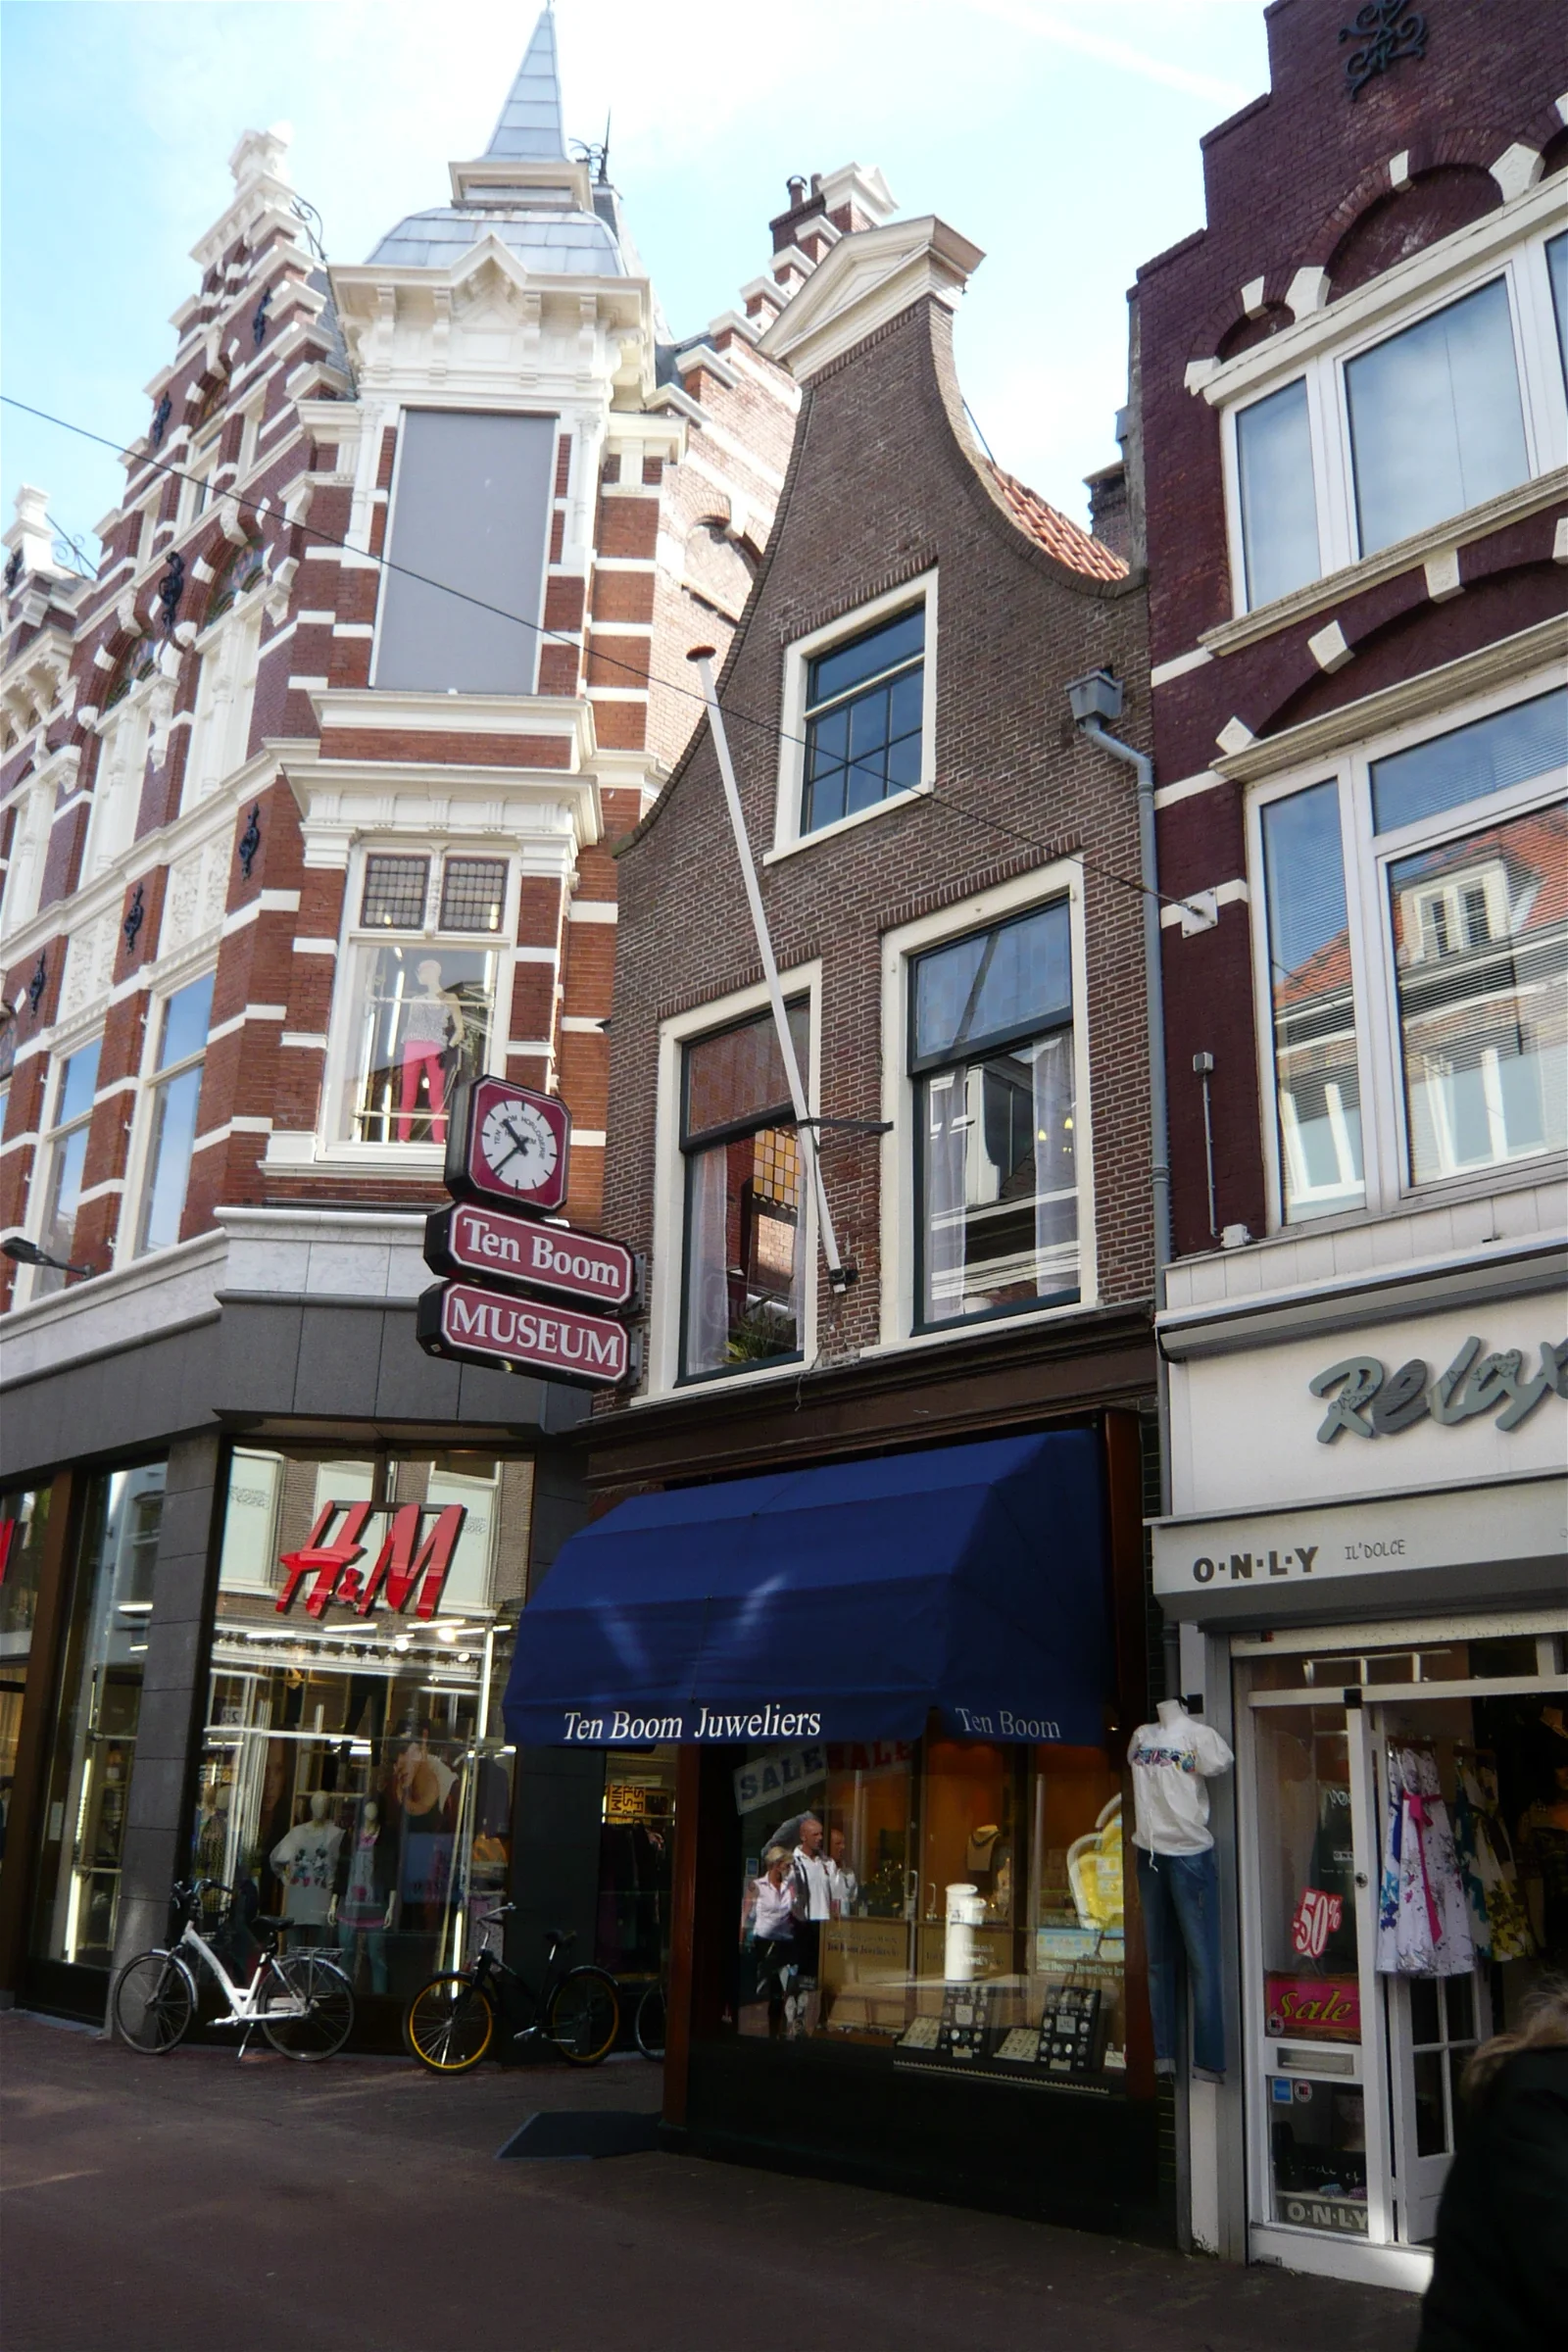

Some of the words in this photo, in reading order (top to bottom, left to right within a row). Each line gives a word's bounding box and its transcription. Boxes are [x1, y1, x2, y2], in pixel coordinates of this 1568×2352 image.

[463, 1216, 520, 1262] Ten
[531, 1235, 620, 1288] Boom
[452, 1298, 620, 1368] MUSEUM
[274, 1500, 466, 1621] H&M
[564, 1711, 604, 1740] Ten
[609, 1710, 683, 1740] Boom
[694, 1703, 821, 1738] Juweliers
[955, 1707, 995, 1734] Ten
[998, 1710, 1063, 1739] Boom
[740, 1745, 824, 1801] SALE
[1276, 1990, 1352, 2022] Sale
